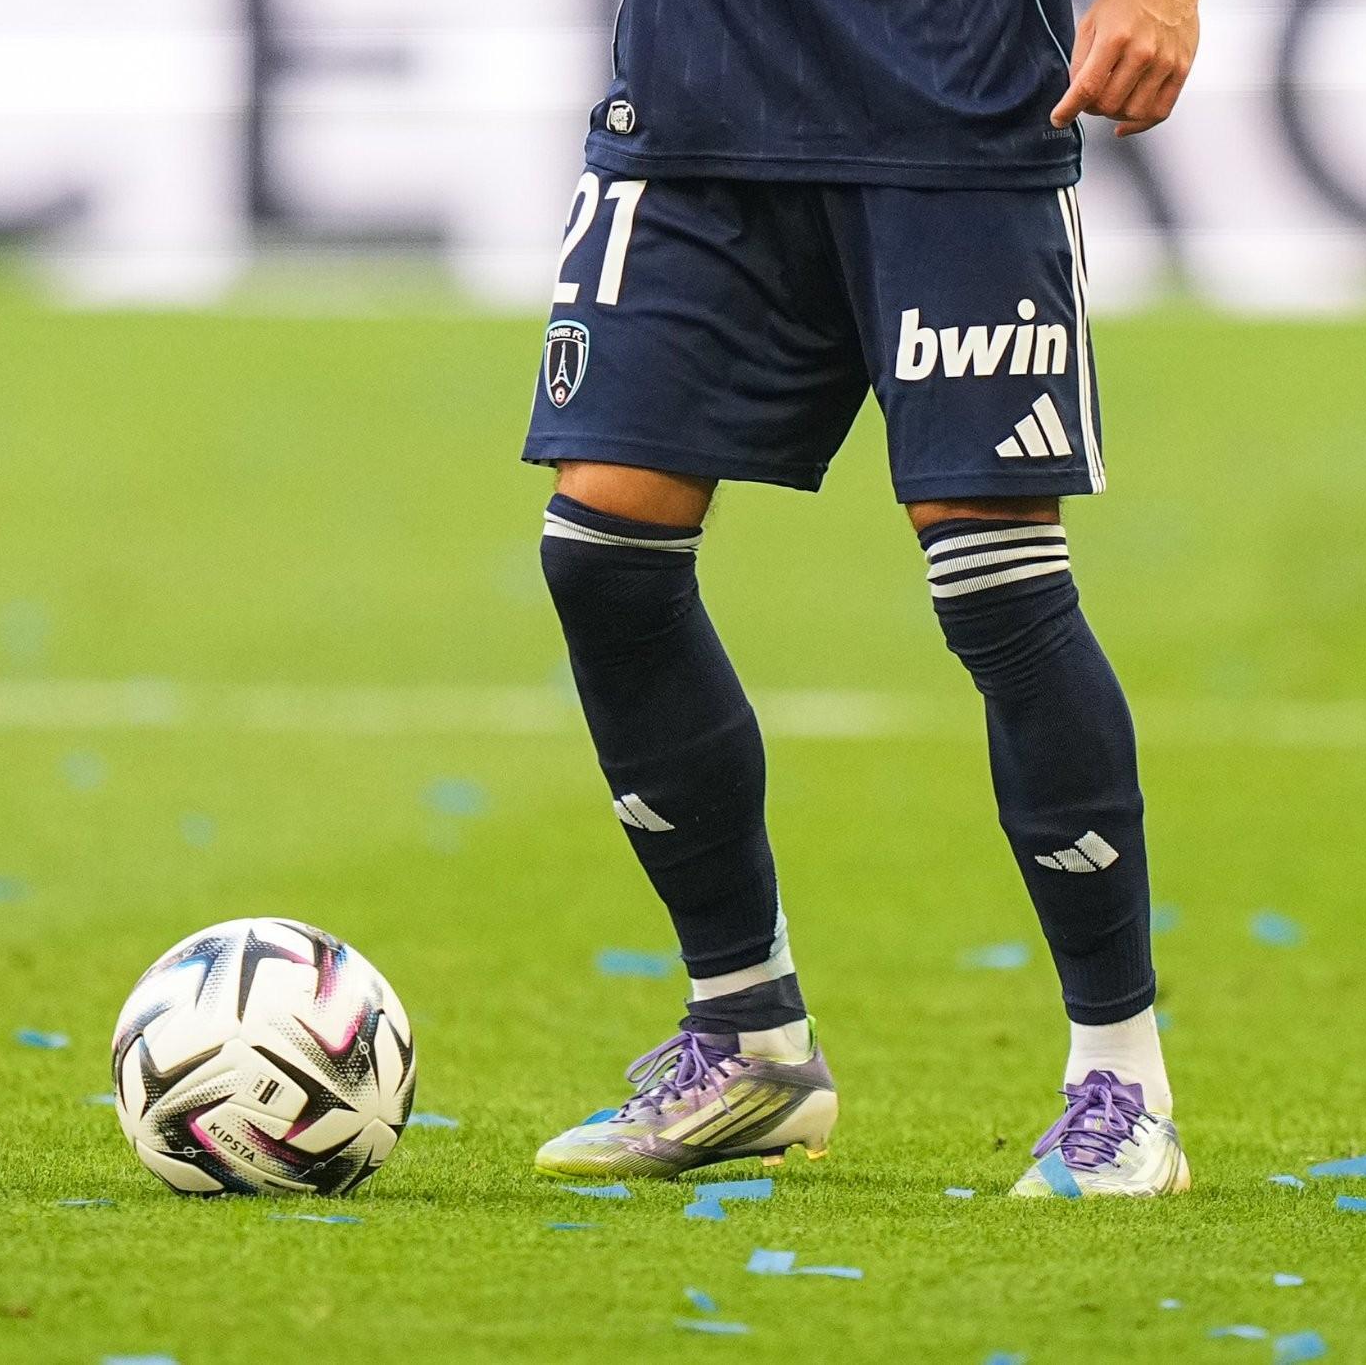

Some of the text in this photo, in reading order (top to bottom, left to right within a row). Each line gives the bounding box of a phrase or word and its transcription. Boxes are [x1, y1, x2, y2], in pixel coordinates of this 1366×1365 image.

[553, 172, 647, 305] 21
[549, 327, 585, 341] PARIS FC
[895, 298, 1067, 381] bwin
[208, 1122, 255, 1163] KIPSTA
